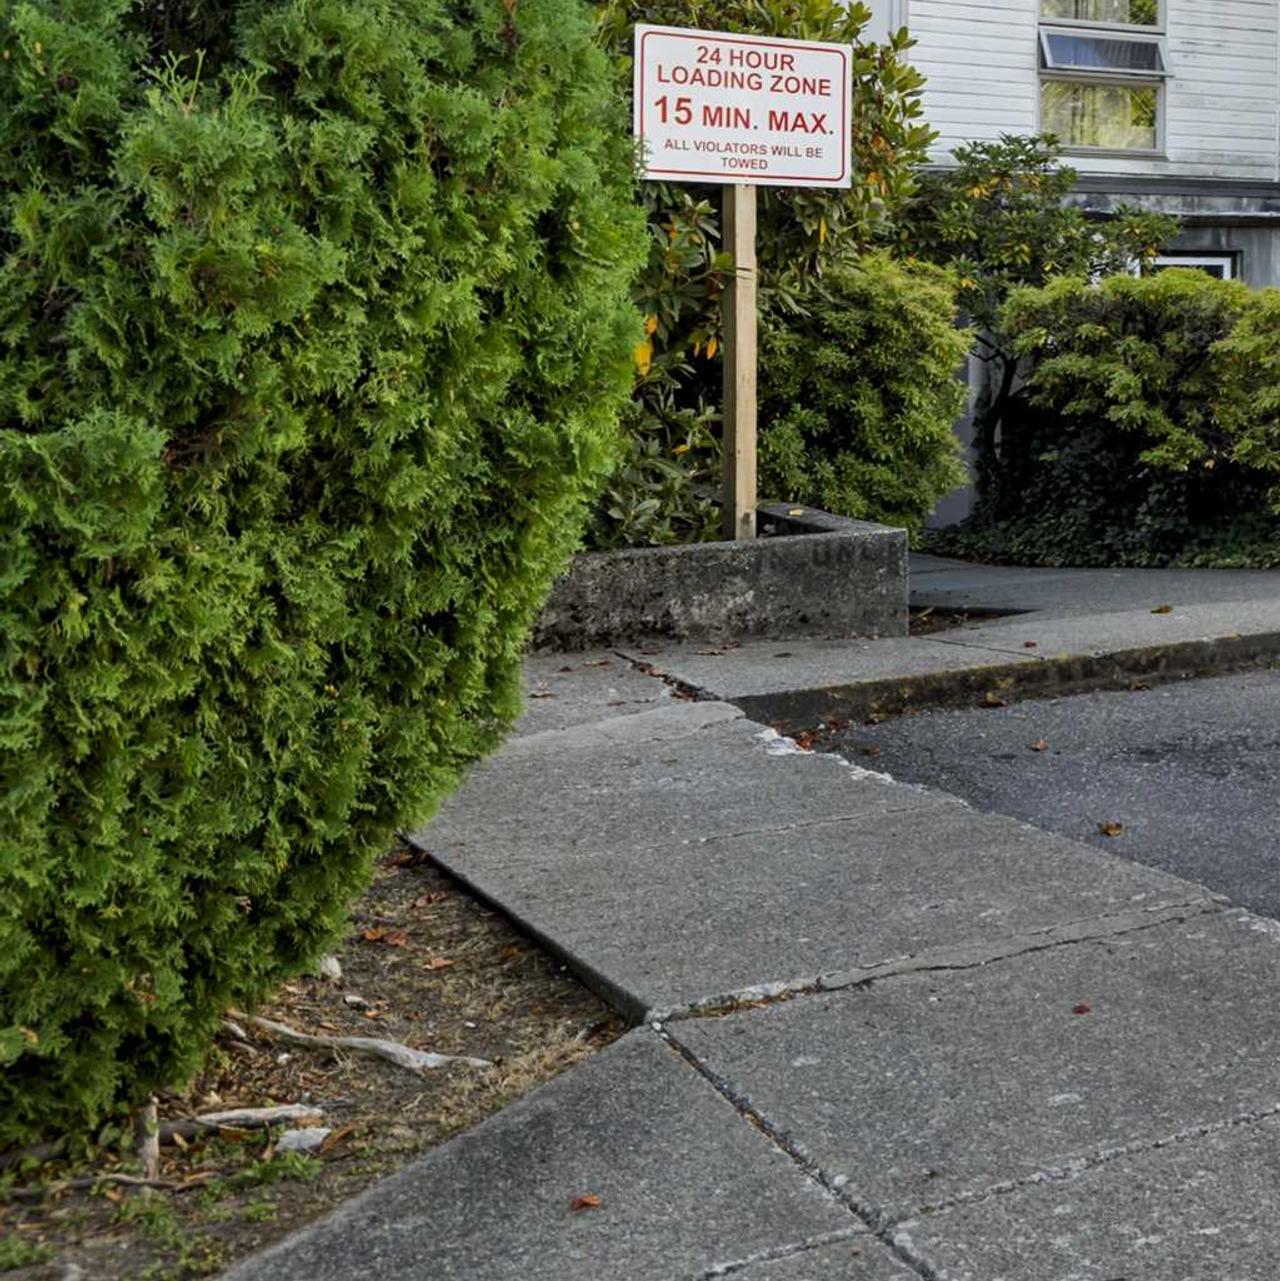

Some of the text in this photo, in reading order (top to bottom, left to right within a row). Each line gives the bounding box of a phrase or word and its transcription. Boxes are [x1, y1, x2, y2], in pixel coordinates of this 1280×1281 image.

[697, 46, 795, 71] 24 HOUR
[657, 65, 831, 96] LOADING ZONE
[654, 95, 834, 135] 15 MIN. MAX.
[664, 138, 823, 158] ALL VIOLATORS WILL BE
[722, 157, 768, 169] TOWED
